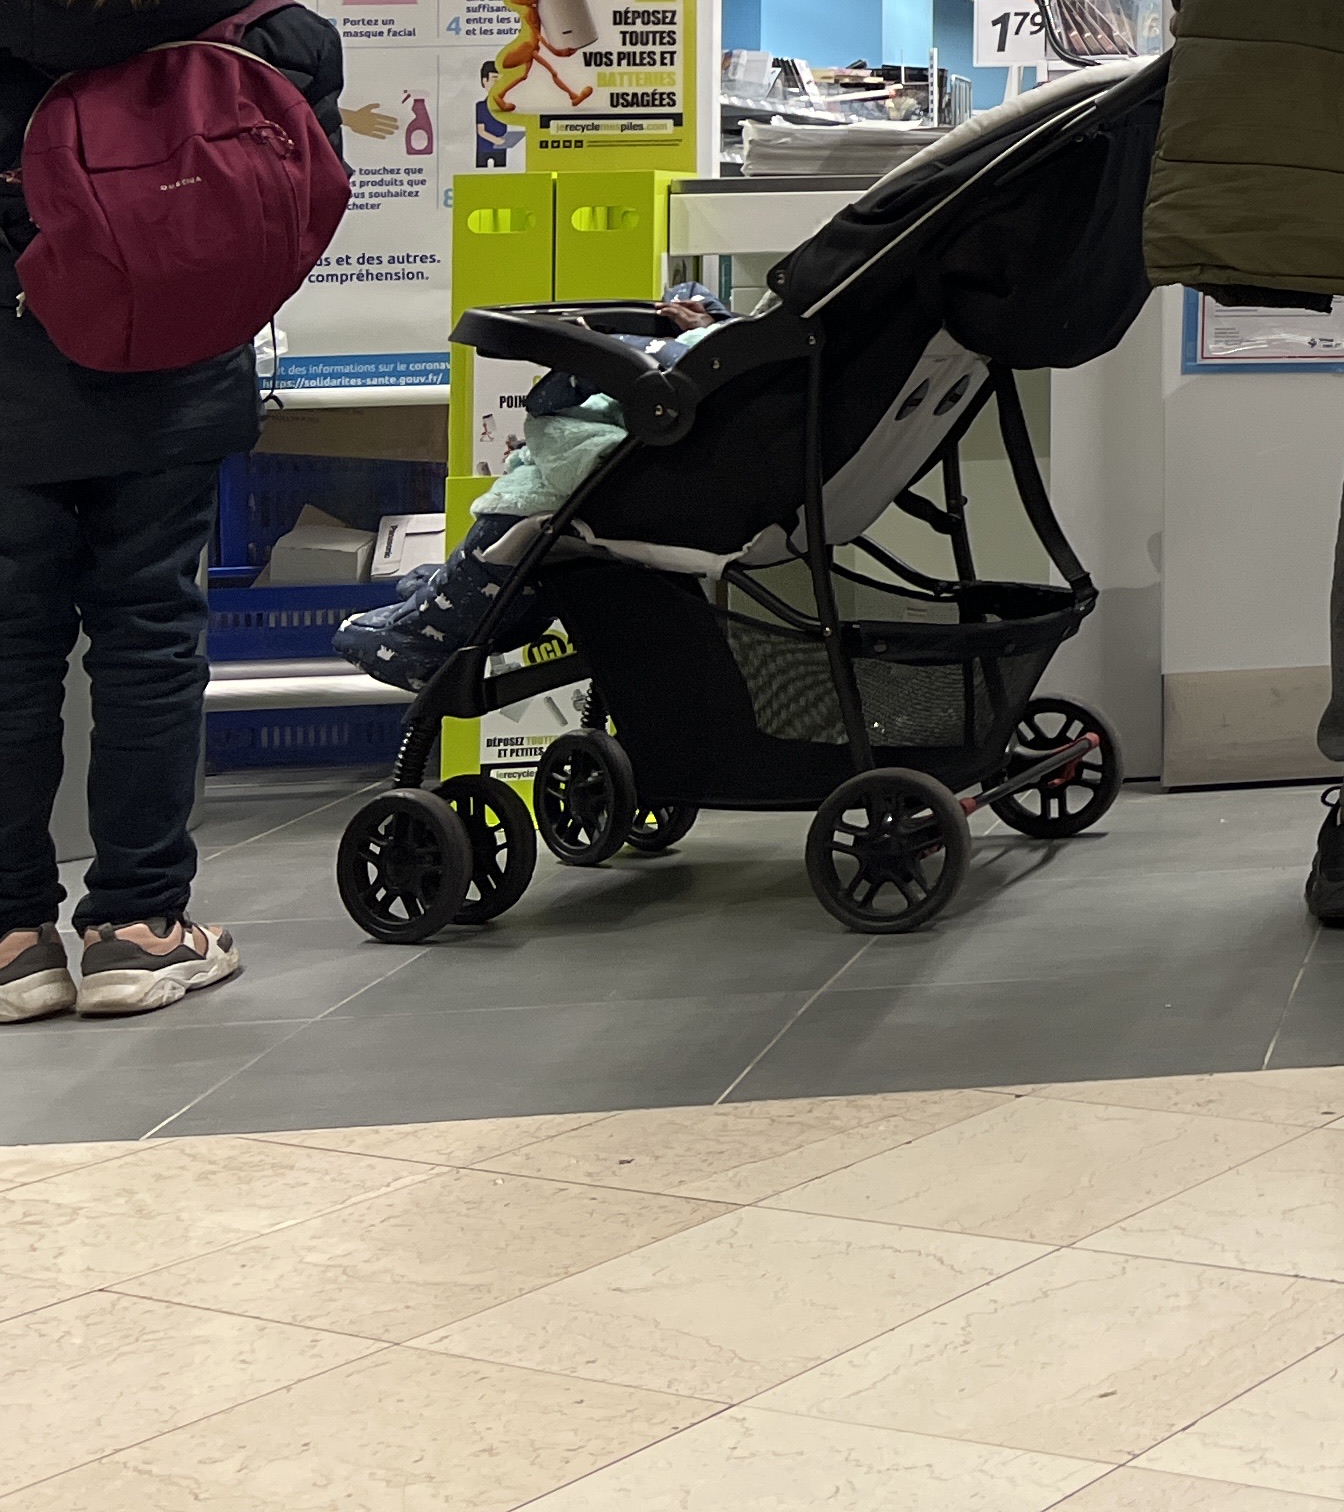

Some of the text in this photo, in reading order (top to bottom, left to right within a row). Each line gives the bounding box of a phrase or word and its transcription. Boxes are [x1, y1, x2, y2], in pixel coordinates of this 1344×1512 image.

[343, 17, 379, 26] Portez
[466, 16, 493, 24] entre
[497, 14, 511, 24] les
[612, 7, 677, 26] DÉPOSEZ
[446, 16, 462, 35] 4
[465, 26, 521, 36] et les autr
[343, 28, 416, 38] masque facial
[620, 31, 677, 46] TOUTES
[582, 51, 677, 67] VOS PILES ET
[610, 89, 677, 108] USAGÉES
[359, 167, 401, 176] touchez
[404, 167, 424, 178] que
[359, 178, 404, 189] produits
[407, 179, 427, 190] que
[368, 189, 420, 199] souhaitez
[346, 202, 382, 210] cheter
[336, 254, 352, 266] et
[356, 253, 383, 266] des
[387, 253, 441, 265] autres.
[308, 268, 430, 285] compréhension.
[288, 365, 307, 375] des
[308, 362, 376, 375] informations
[378, 364, 395, 373] sur
[396, 361, 407, 371] le
[409, 362, 450, 371] coronav
[500, 396, 527, 409] POIN
[532, 639, 562, 663] ICI
[486, 736, 525, 748] DÉPOSEZ
[498, 746, 544, 758] ET PETITES
[496, 769, 536, 780] jerecycle
